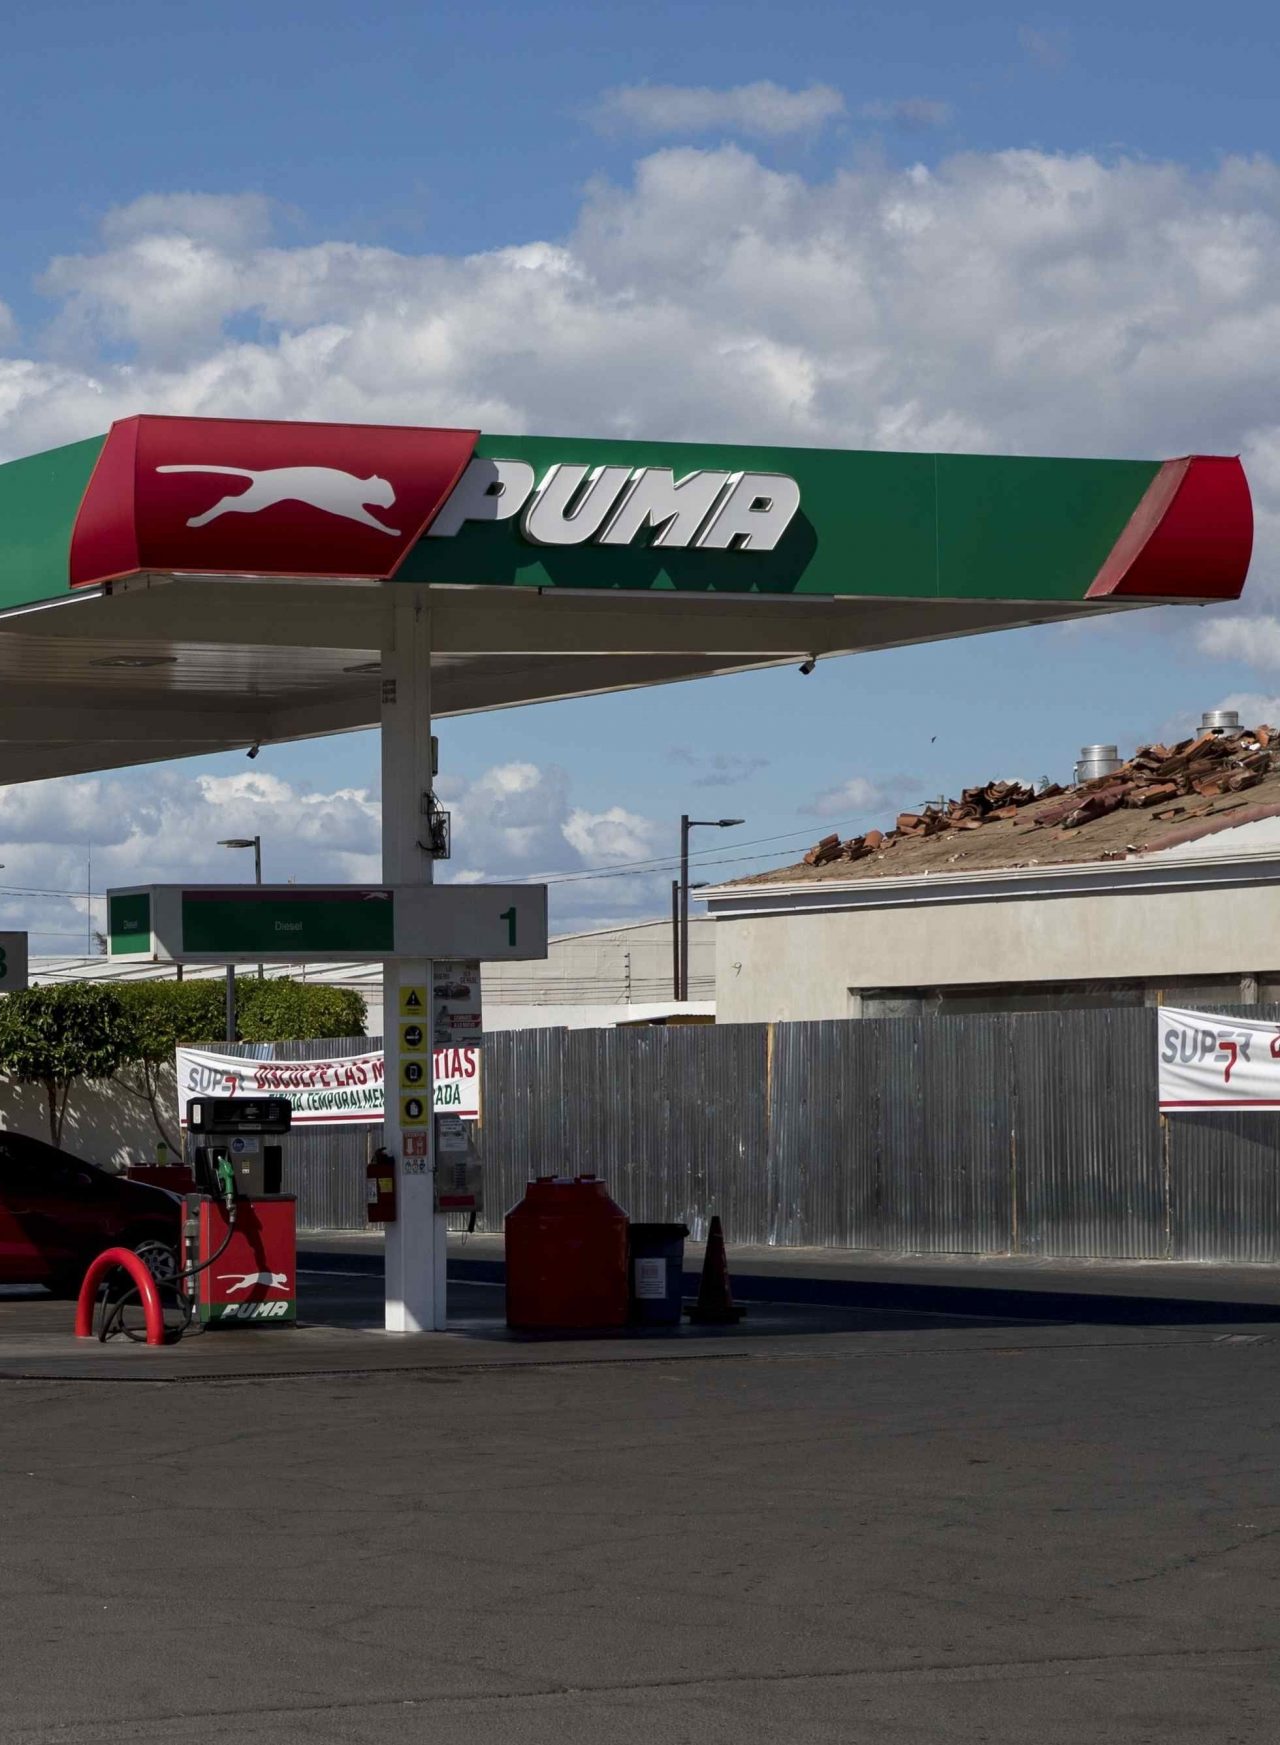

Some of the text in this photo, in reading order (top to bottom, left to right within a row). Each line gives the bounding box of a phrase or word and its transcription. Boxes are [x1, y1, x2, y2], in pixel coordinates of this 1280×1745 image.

[424, 458, 801, 551] PUMA
[500, 907, 516, 946] 1
[253, 1063, 333, 1089] DISCULPE
[333, 1060, 371, 1087] LAS
[220, 1301, 289, 1319] PUMA
